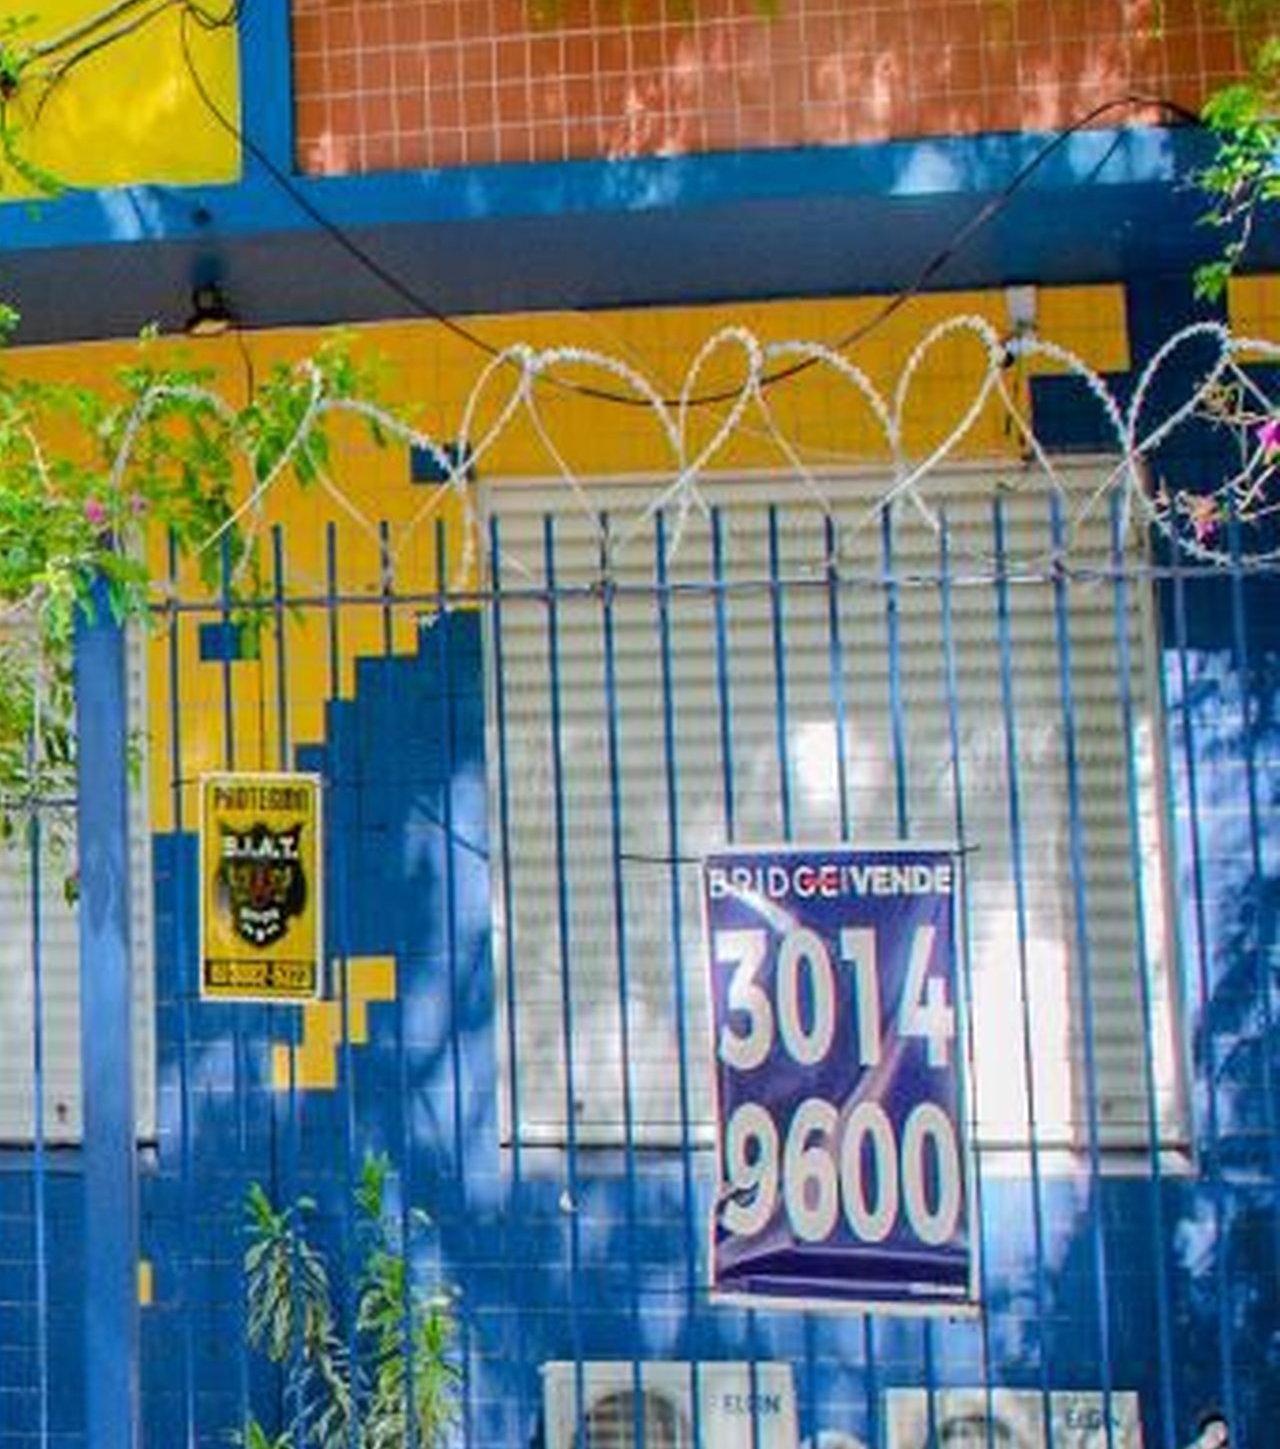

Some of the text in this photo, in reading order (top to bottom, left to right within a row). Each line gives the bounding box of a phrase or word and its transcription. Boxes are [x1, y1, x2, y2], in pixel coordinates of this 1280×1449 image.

[709, 864, 951, 898] BRIDGE VENDE
[714, 925, 954, 1069] 3014
[720, 1098, 961, 1243] 9600
